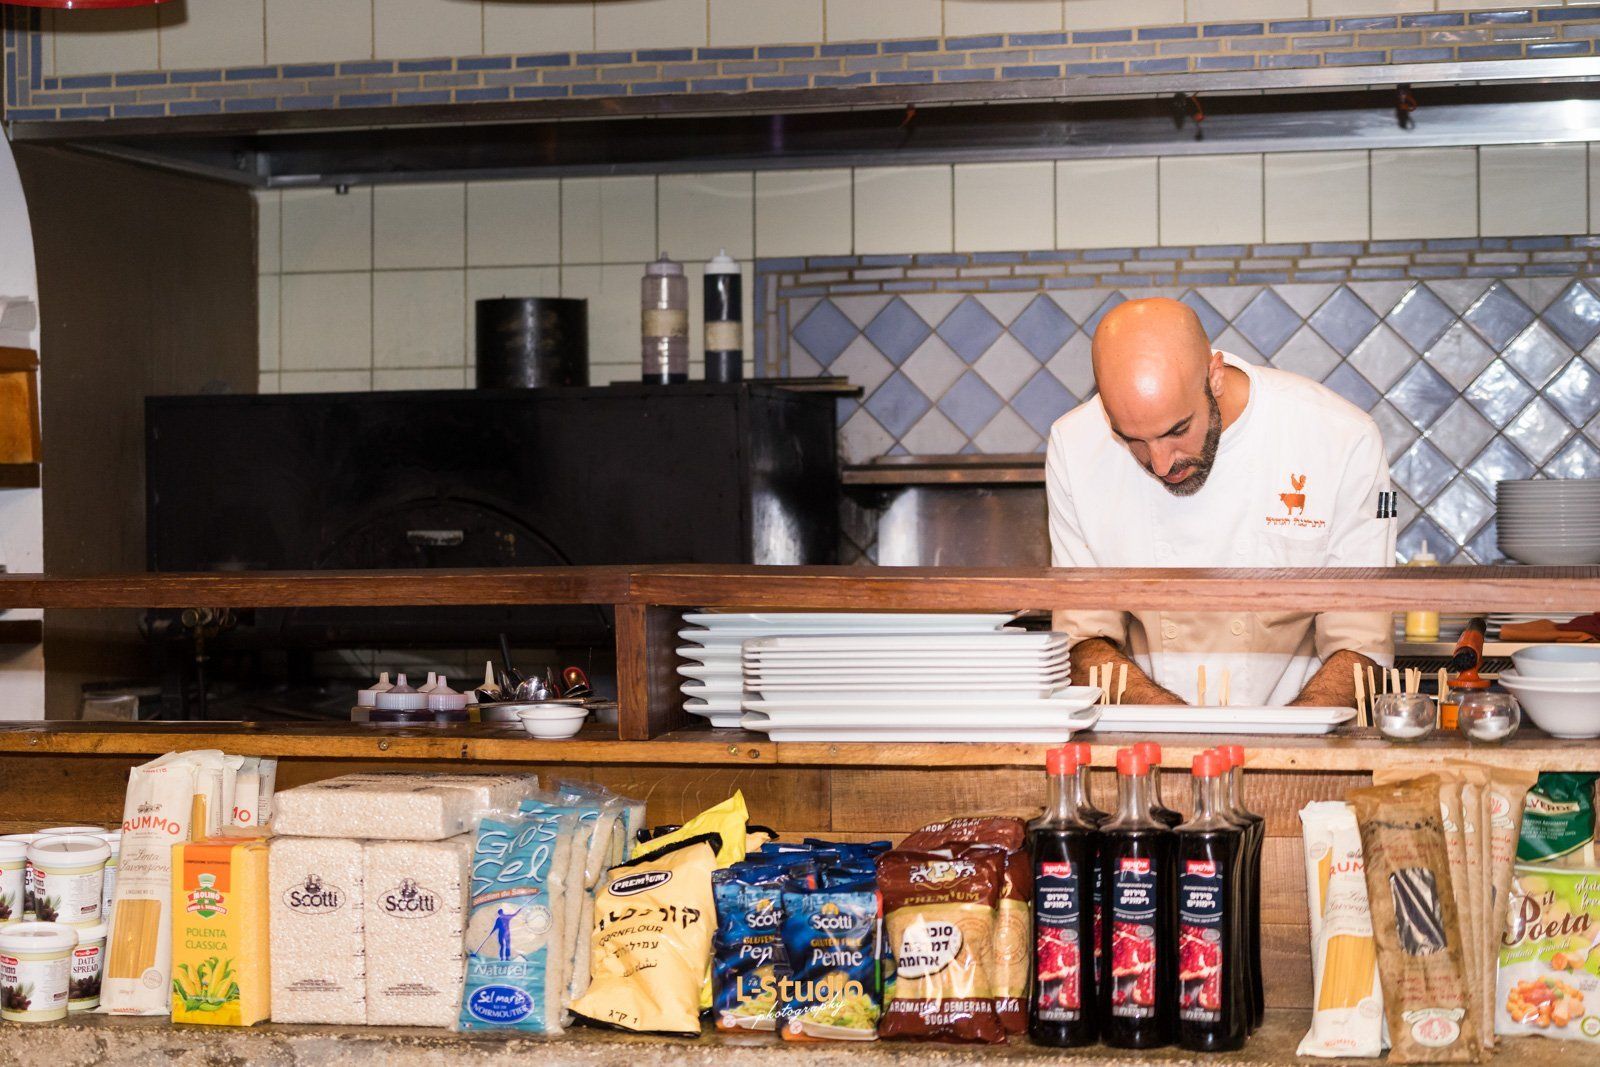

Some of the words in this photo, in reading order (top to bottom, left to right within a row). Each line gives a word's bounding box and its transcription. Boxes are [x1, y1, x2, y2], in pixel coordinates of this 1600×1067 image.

[122, 815, 180, 835] RUMMO
[476, 823, 557, 859] Gros
[472, 844, 550, 897] Sel
[1329, 861, 1365, 878] RUM
[290, 891, 338, 908] Scotti
[386, 896, 434, 912] Scotti
[1543, 889, 1555, 906] il
[747, 912, 784, 928] Scott
[812, 914, 852, 929] Scotti
[1502, 892, 1591, 946] Poeta
[186, 927, 228, 938] POLENTA
[599, 925, 664, 947] CORNFLOUR
[926, 926, 953, 937] סוכ
[185, 940, 228, 951] CLASSICA
[740, 945, 773, 961] Pen
[904, 940, 949, 953] דמה
[77, 956, 96, 966] DATE
[812, 949, 863, 967] Penne
[72, 963, 99, 973] SPREAD
[474, 962, 528, 977] Naturel
[477, 991, 495, 1003] Sel
[943, 1001, 992, 1013] DEMERARA
